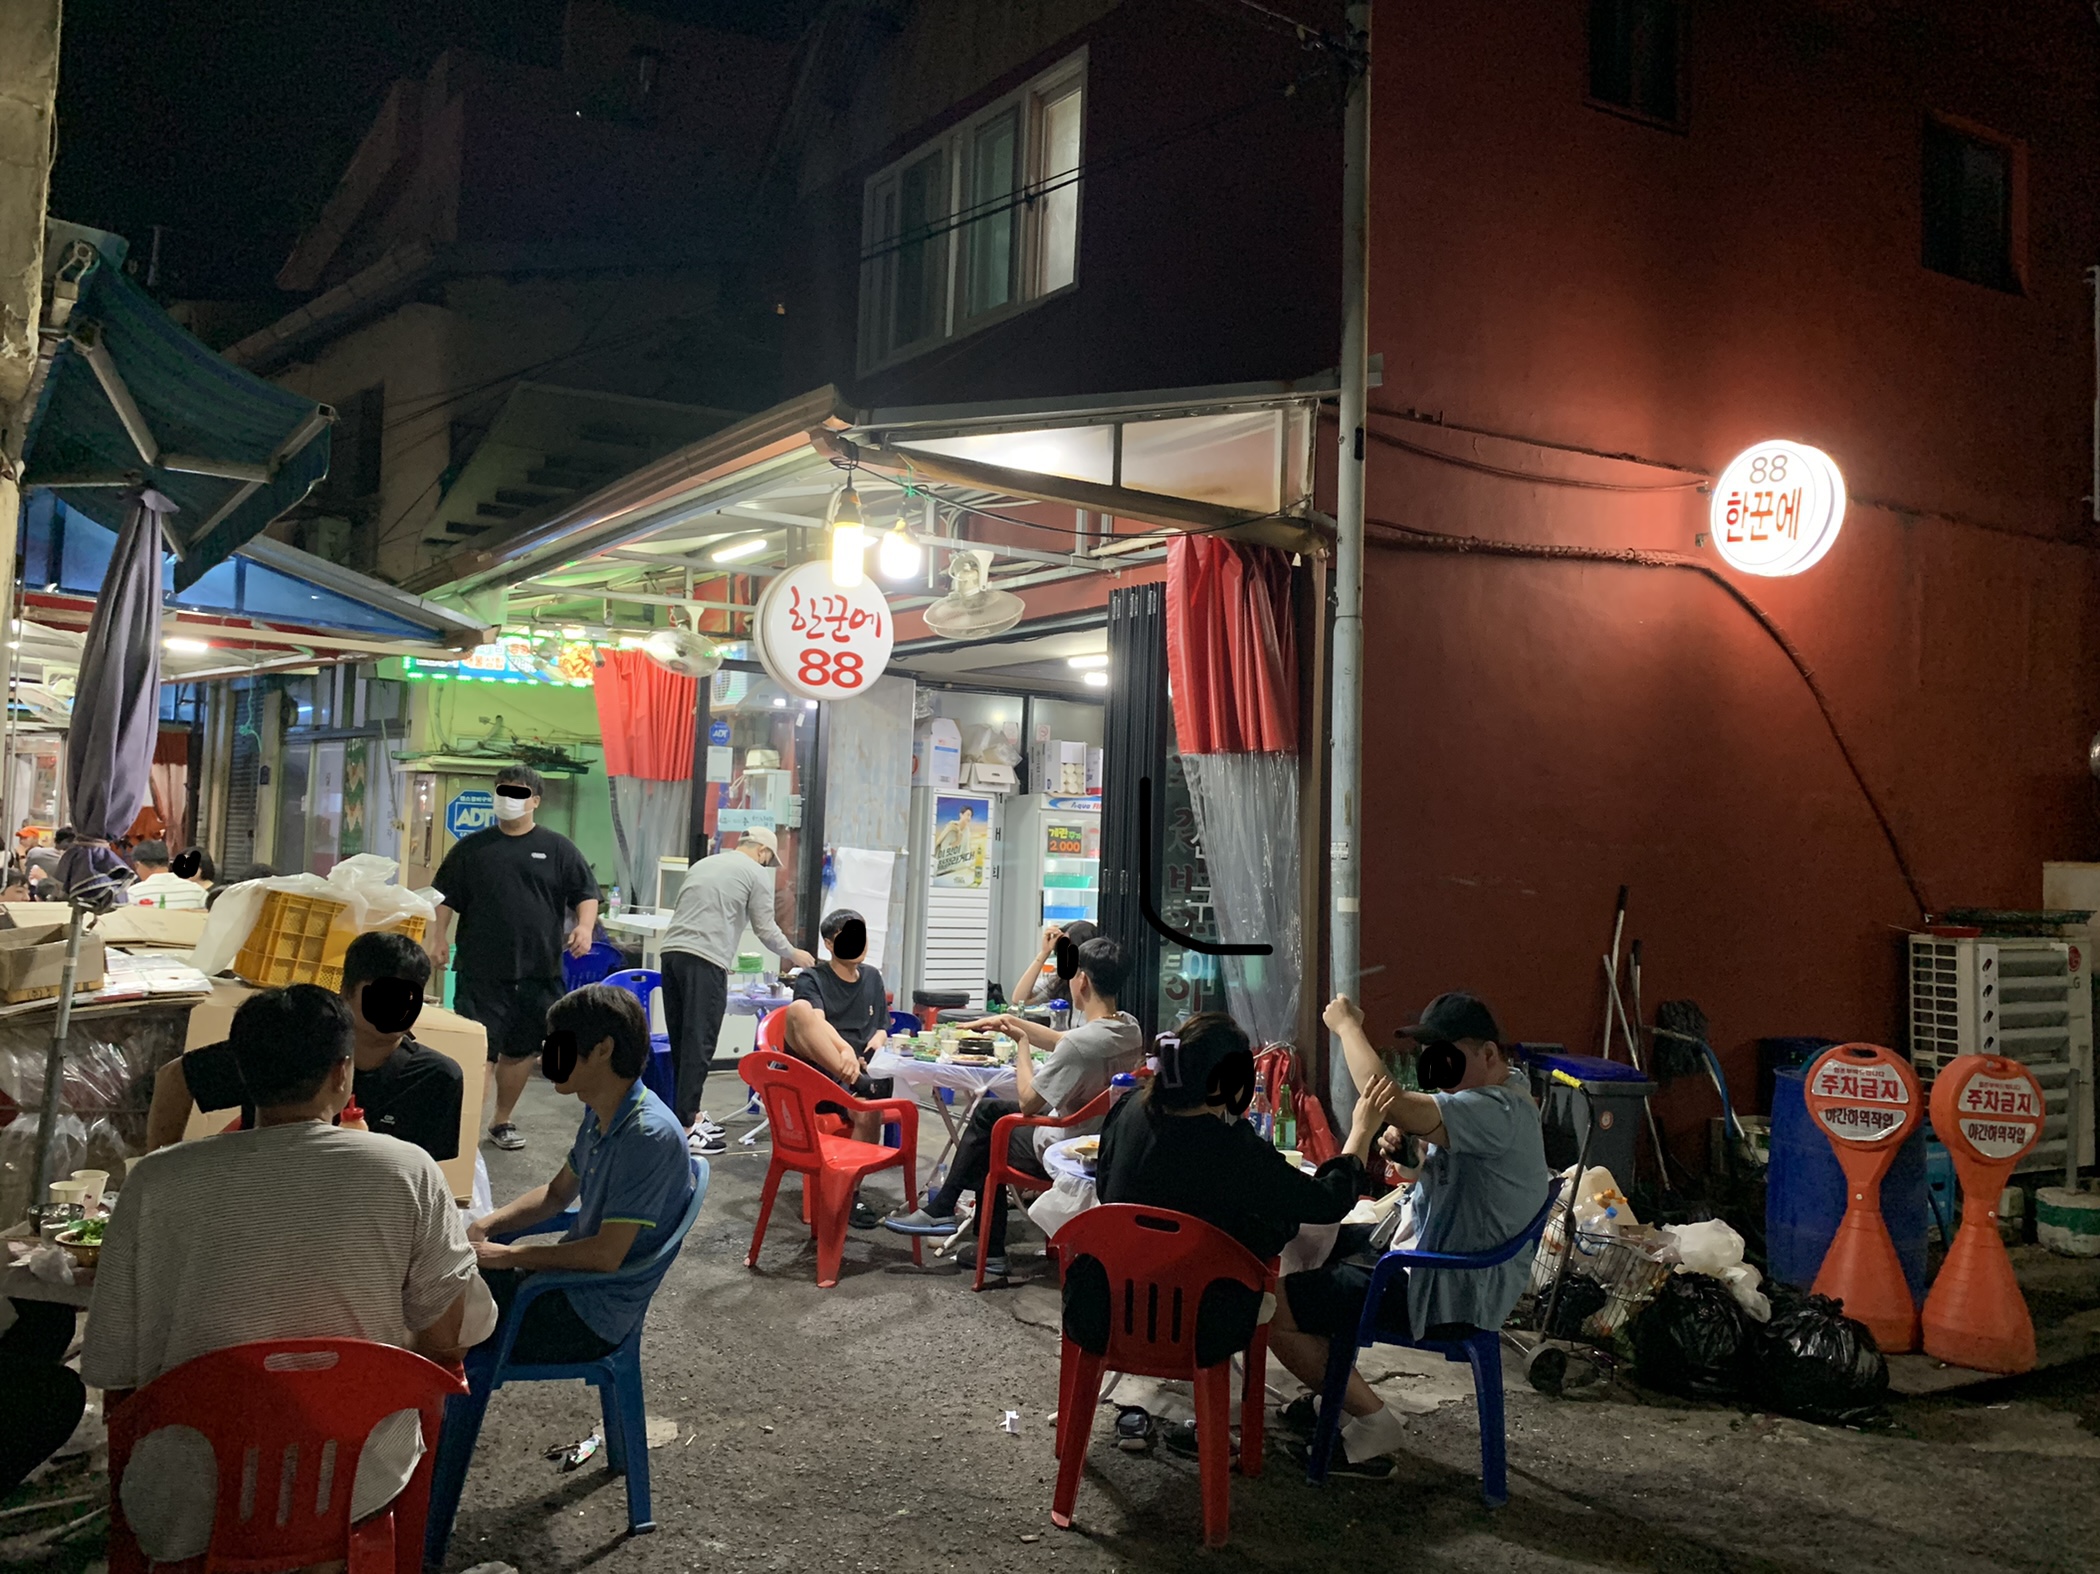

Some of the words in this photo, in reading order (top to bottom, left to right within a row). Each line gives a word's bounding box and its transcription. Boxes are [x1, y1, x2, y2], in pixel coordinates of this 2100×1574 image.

[1750, 454, 1788, 484] 88
[1726, 487, 1802, 542] 한꾼에
[789, 585, 882, 643] 한꾼에
[797, 648, 864, 688] 88
[1821, 1074, 1899, 1101] 주차금지
[1967, 1089, 2032, 1114] 주차금지
[1825, 1107, 1894, 1129] 야간하역작업
[1968, 1123, 2026, 1144] 야간하역작업
